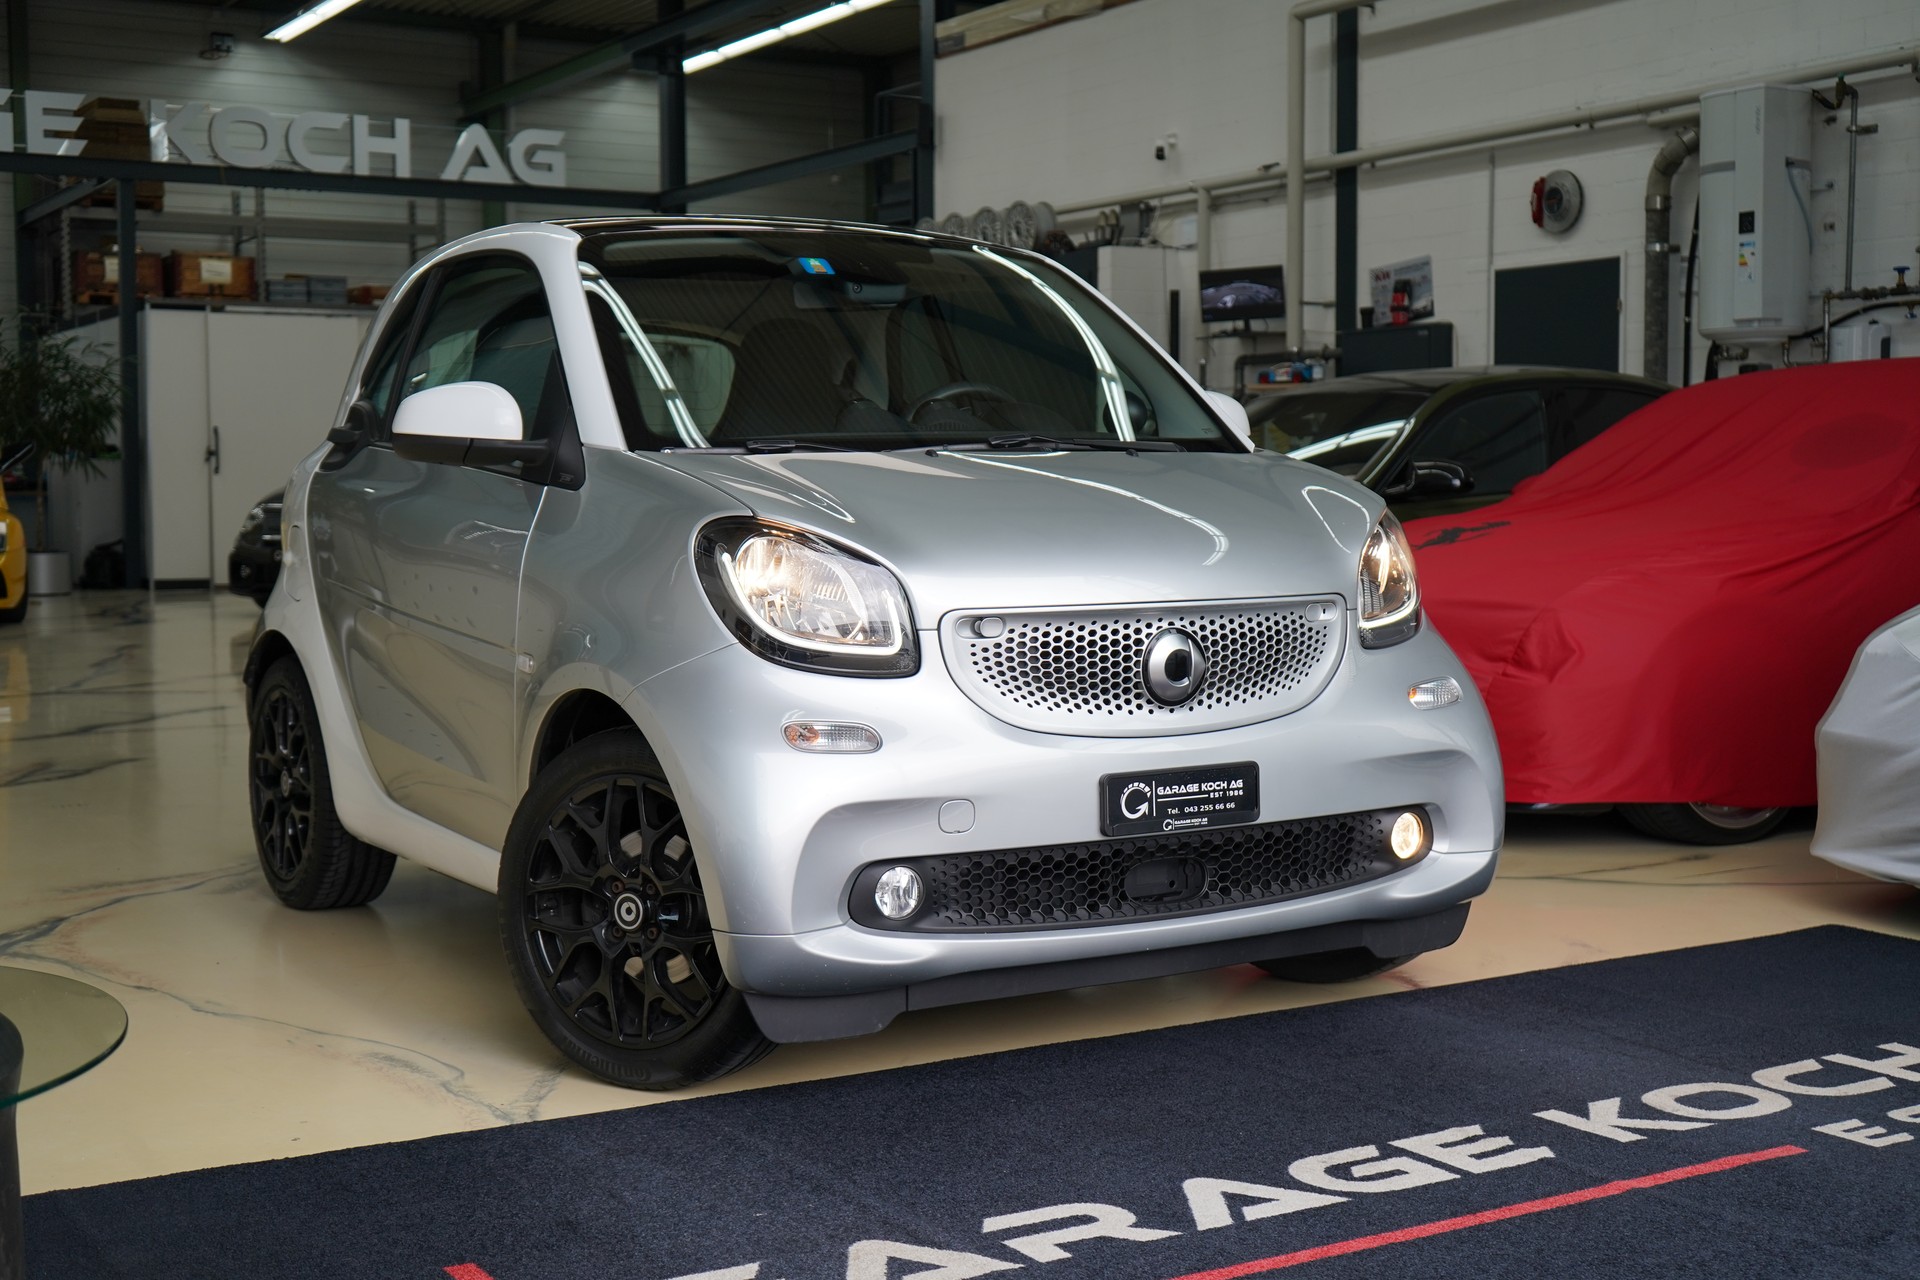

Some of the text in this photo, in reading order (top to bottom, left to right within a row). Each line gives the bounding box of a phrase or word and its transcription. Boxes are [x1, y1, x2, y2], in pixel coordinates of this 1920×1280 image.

[0, 88, 567, 187] E KOCH AG
[1157, 779, 1244, 795] GARAGE KOCH AG
[1226, 789, 1244, 797] 1986
[1200, 804, 1214, 812] 255
[663, 1124, 1556, 1280] ARAGE
